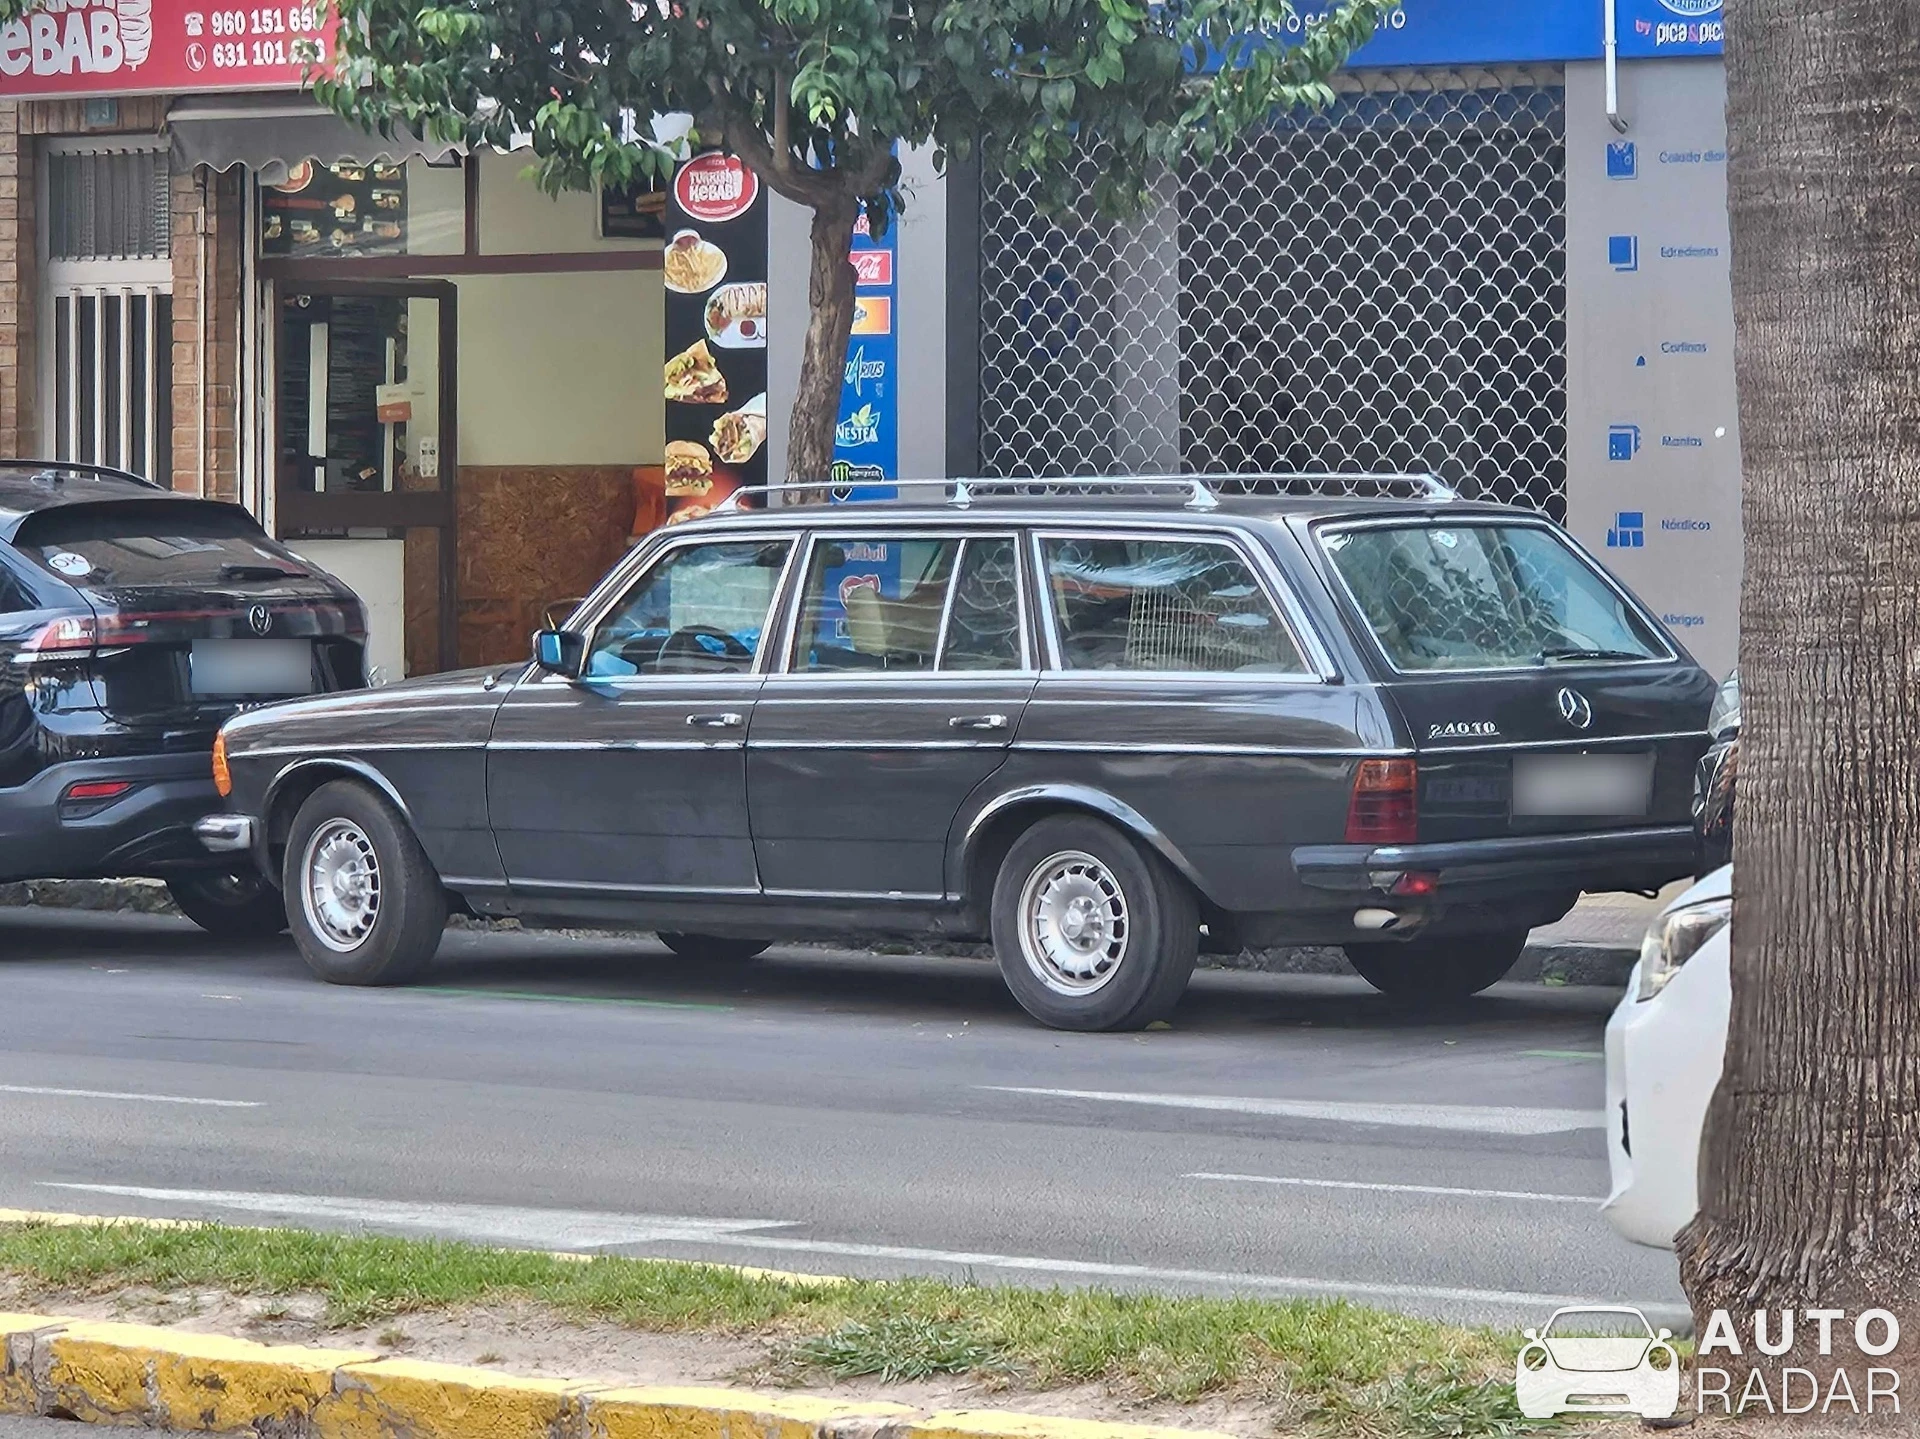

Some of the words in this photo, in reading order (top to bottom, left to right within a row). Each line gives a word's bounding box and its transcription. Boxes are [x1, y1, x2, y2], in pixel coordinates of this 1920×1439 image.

[211, 10, 246, 36] 960
[251, 7, 285, 34] 151
[289, 6, 327, 32] 65
[1635, 19, 1651, 36] by
[0, 11, 124, 76] eBAB
[213, 41, 249, 68] 631
[252, 40, 287, 66] 101
